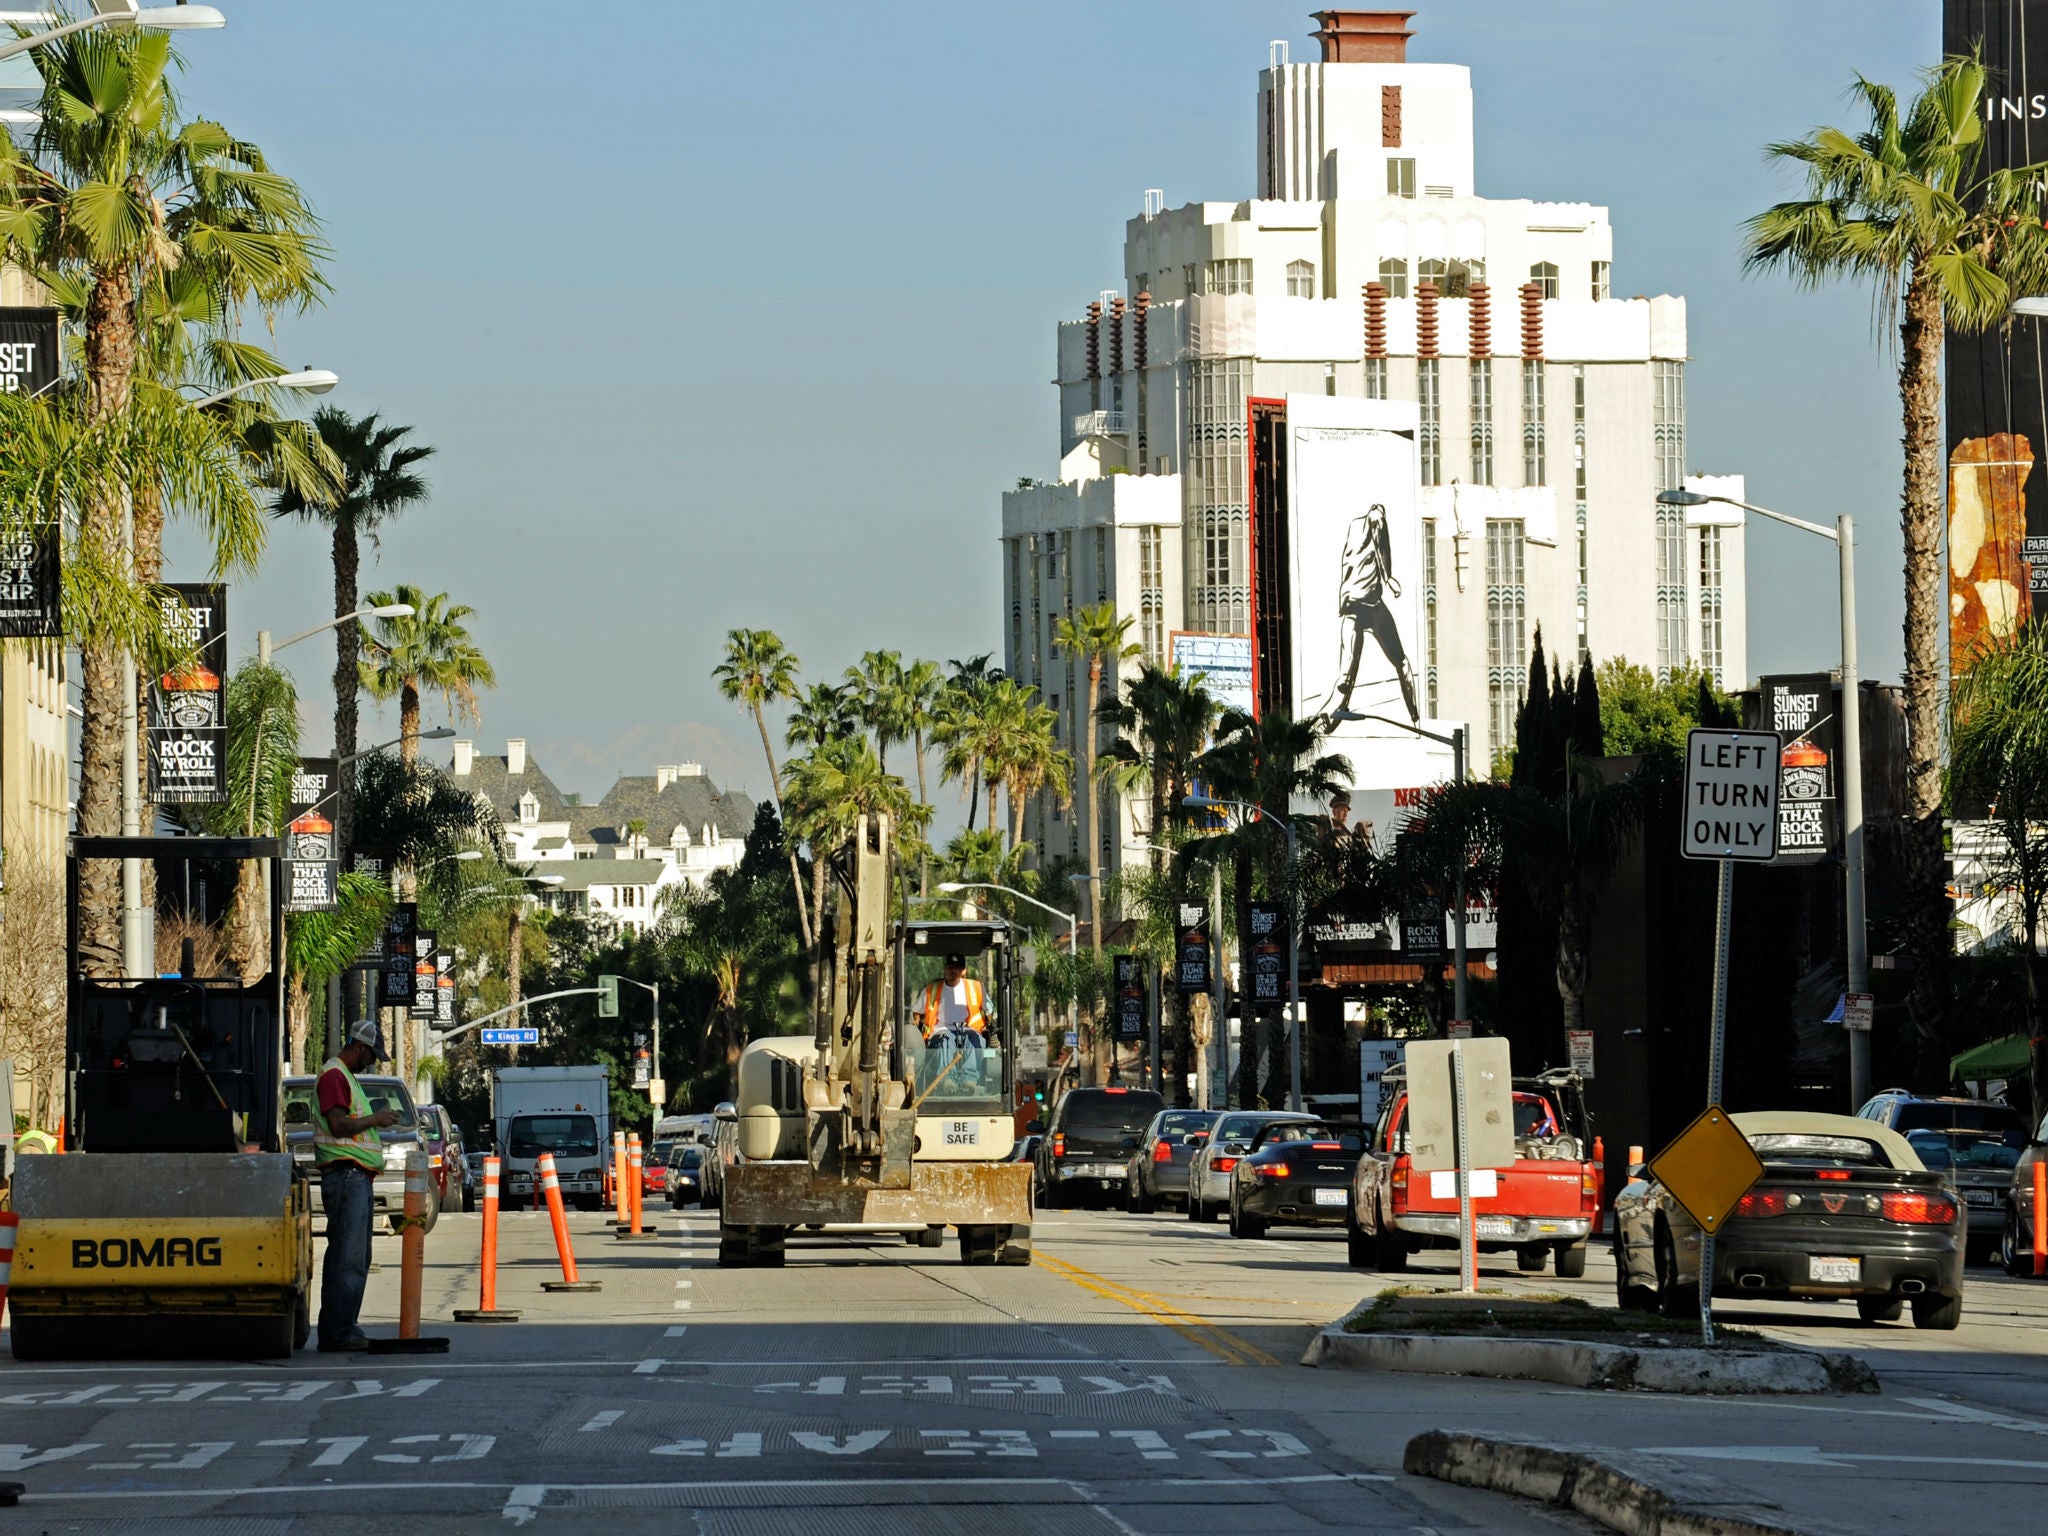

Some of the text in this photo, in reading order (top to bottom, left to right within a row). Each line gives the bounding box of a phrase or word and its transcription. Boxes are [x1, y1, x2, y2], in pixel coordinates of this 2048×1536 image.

[1987, 94, 2048, 121] INS
[2027, 539, 2048, 551] PAR
[1773, 686, 1790, 695] THE
[1773, 694, 1819, 713] SUNSET
[1774, 712, 1810, 731] STRIP
[182, 733, 193, 741] AS
[160, 740, 215, 757] ROCK
[1700, 744, 1767, 769] LEFT
[178, 757, 215, 770] ROLL
[291, 774, 328, 790] SUNSET
[291, 789, 320, 804] STRIP
[1696, 782, 1769, 808] TURN
[1779, 809, 1823, 822] THAT
[1694, 819, 1767, 846] ONLY
[1779, 821, 1823, 834] ROCK
[1780, 833, 1824, 846] BUILT.
[353, 858, 383, 871] SUNSET
[292, 867, 327, 878] THAT
[292, 877, 327, 888] ROCK
[1180, 907, 1203, 917] SUNSET
[1181, 917, 1199, 927] STRIP
[1251, 913, 1277, 924] SUNSET
[1252, 924, 1273, 934] STRIP
[1407, 925, 1439, 936] ROCK
[1418, 936, 1440, 944] ROLL
[498, 1033, 520, 1042] Kings
[1379, 1051, 1397, 1061] THU
[1379, 1083, 1393, 1092] FRI
[953, 1122, 968, 1132] BE
[946, 1134, 976, 1144] SAFE
[72, 1237, 222, 1268] BOMAG
